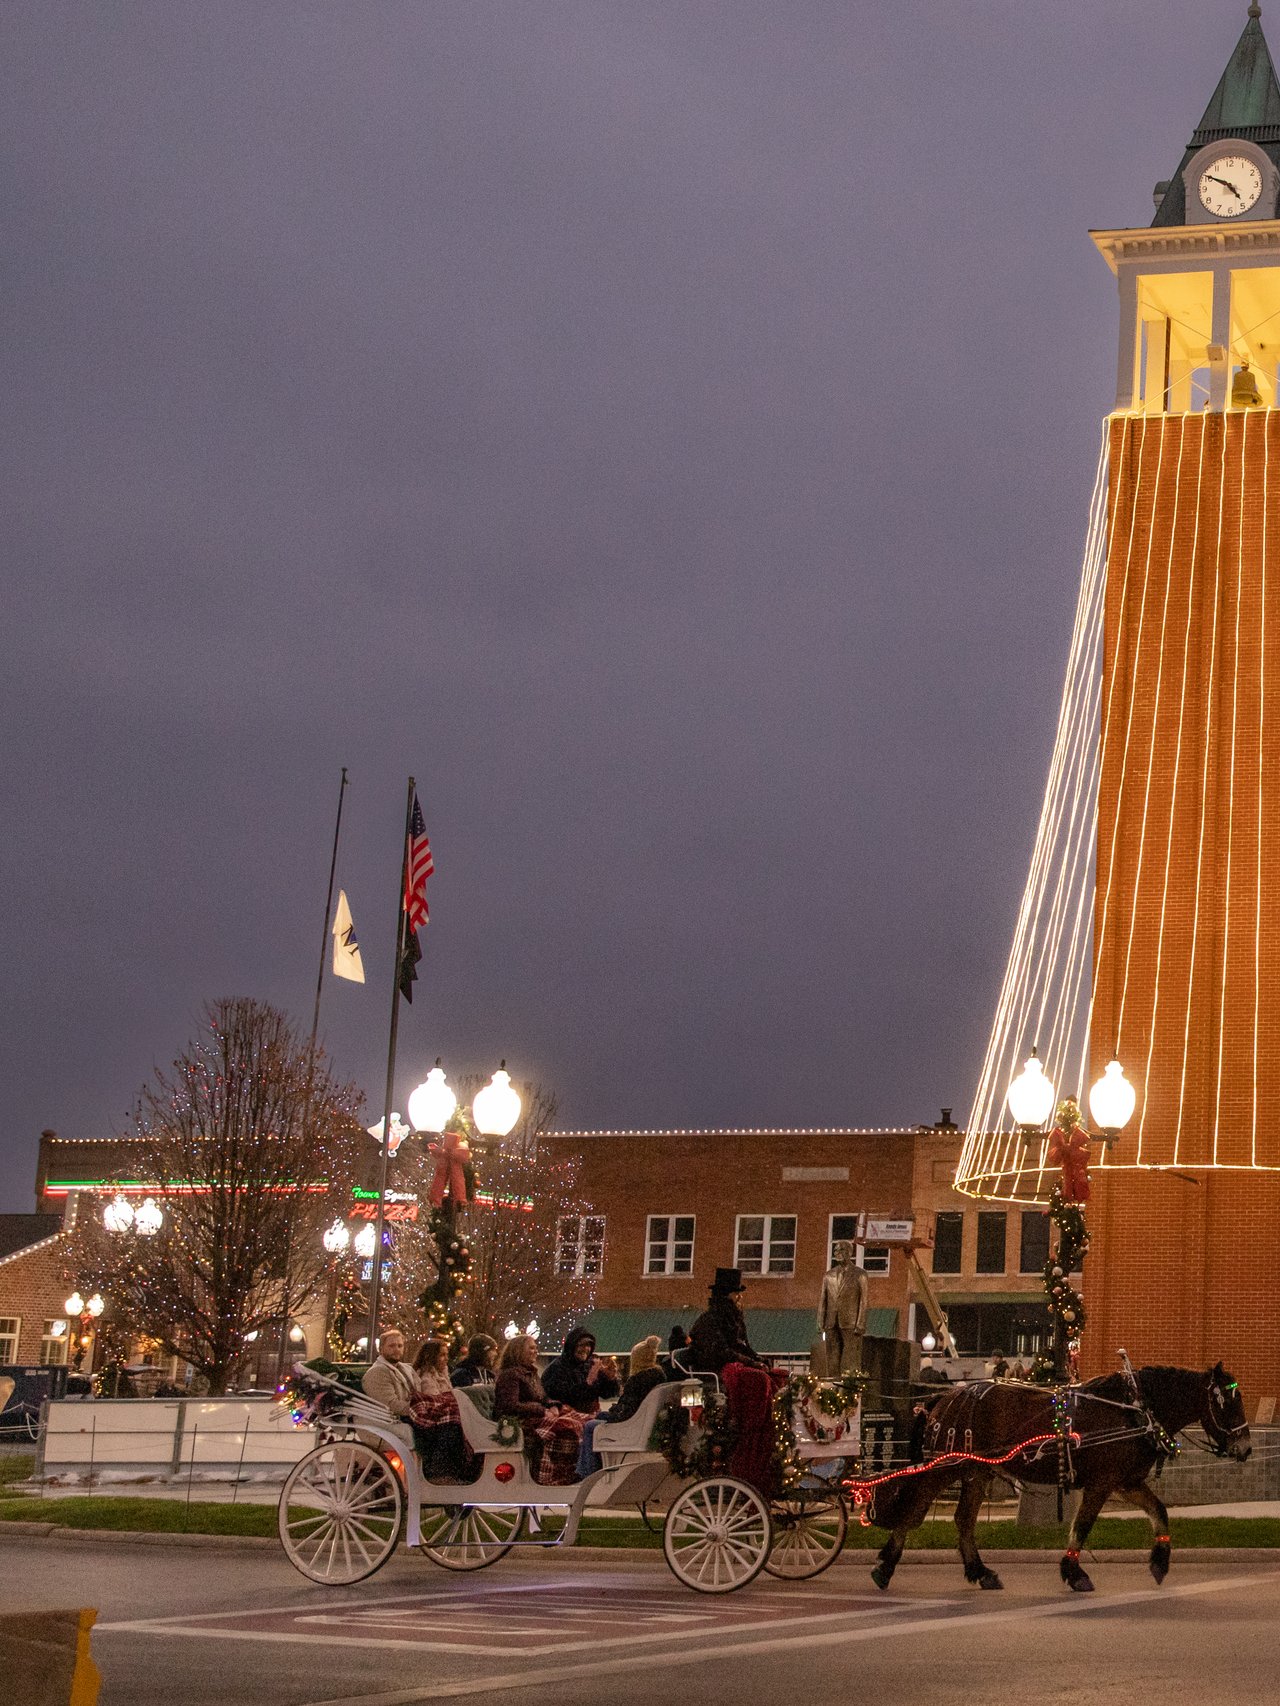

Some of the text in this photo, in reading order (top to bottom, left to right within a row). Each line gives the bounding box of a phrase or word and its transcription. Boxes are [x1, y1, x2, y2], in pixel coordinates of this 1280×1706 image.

[352, 1186, 418, 1202] Town Square
[348, 1203, 419, 1220] PIZZA
